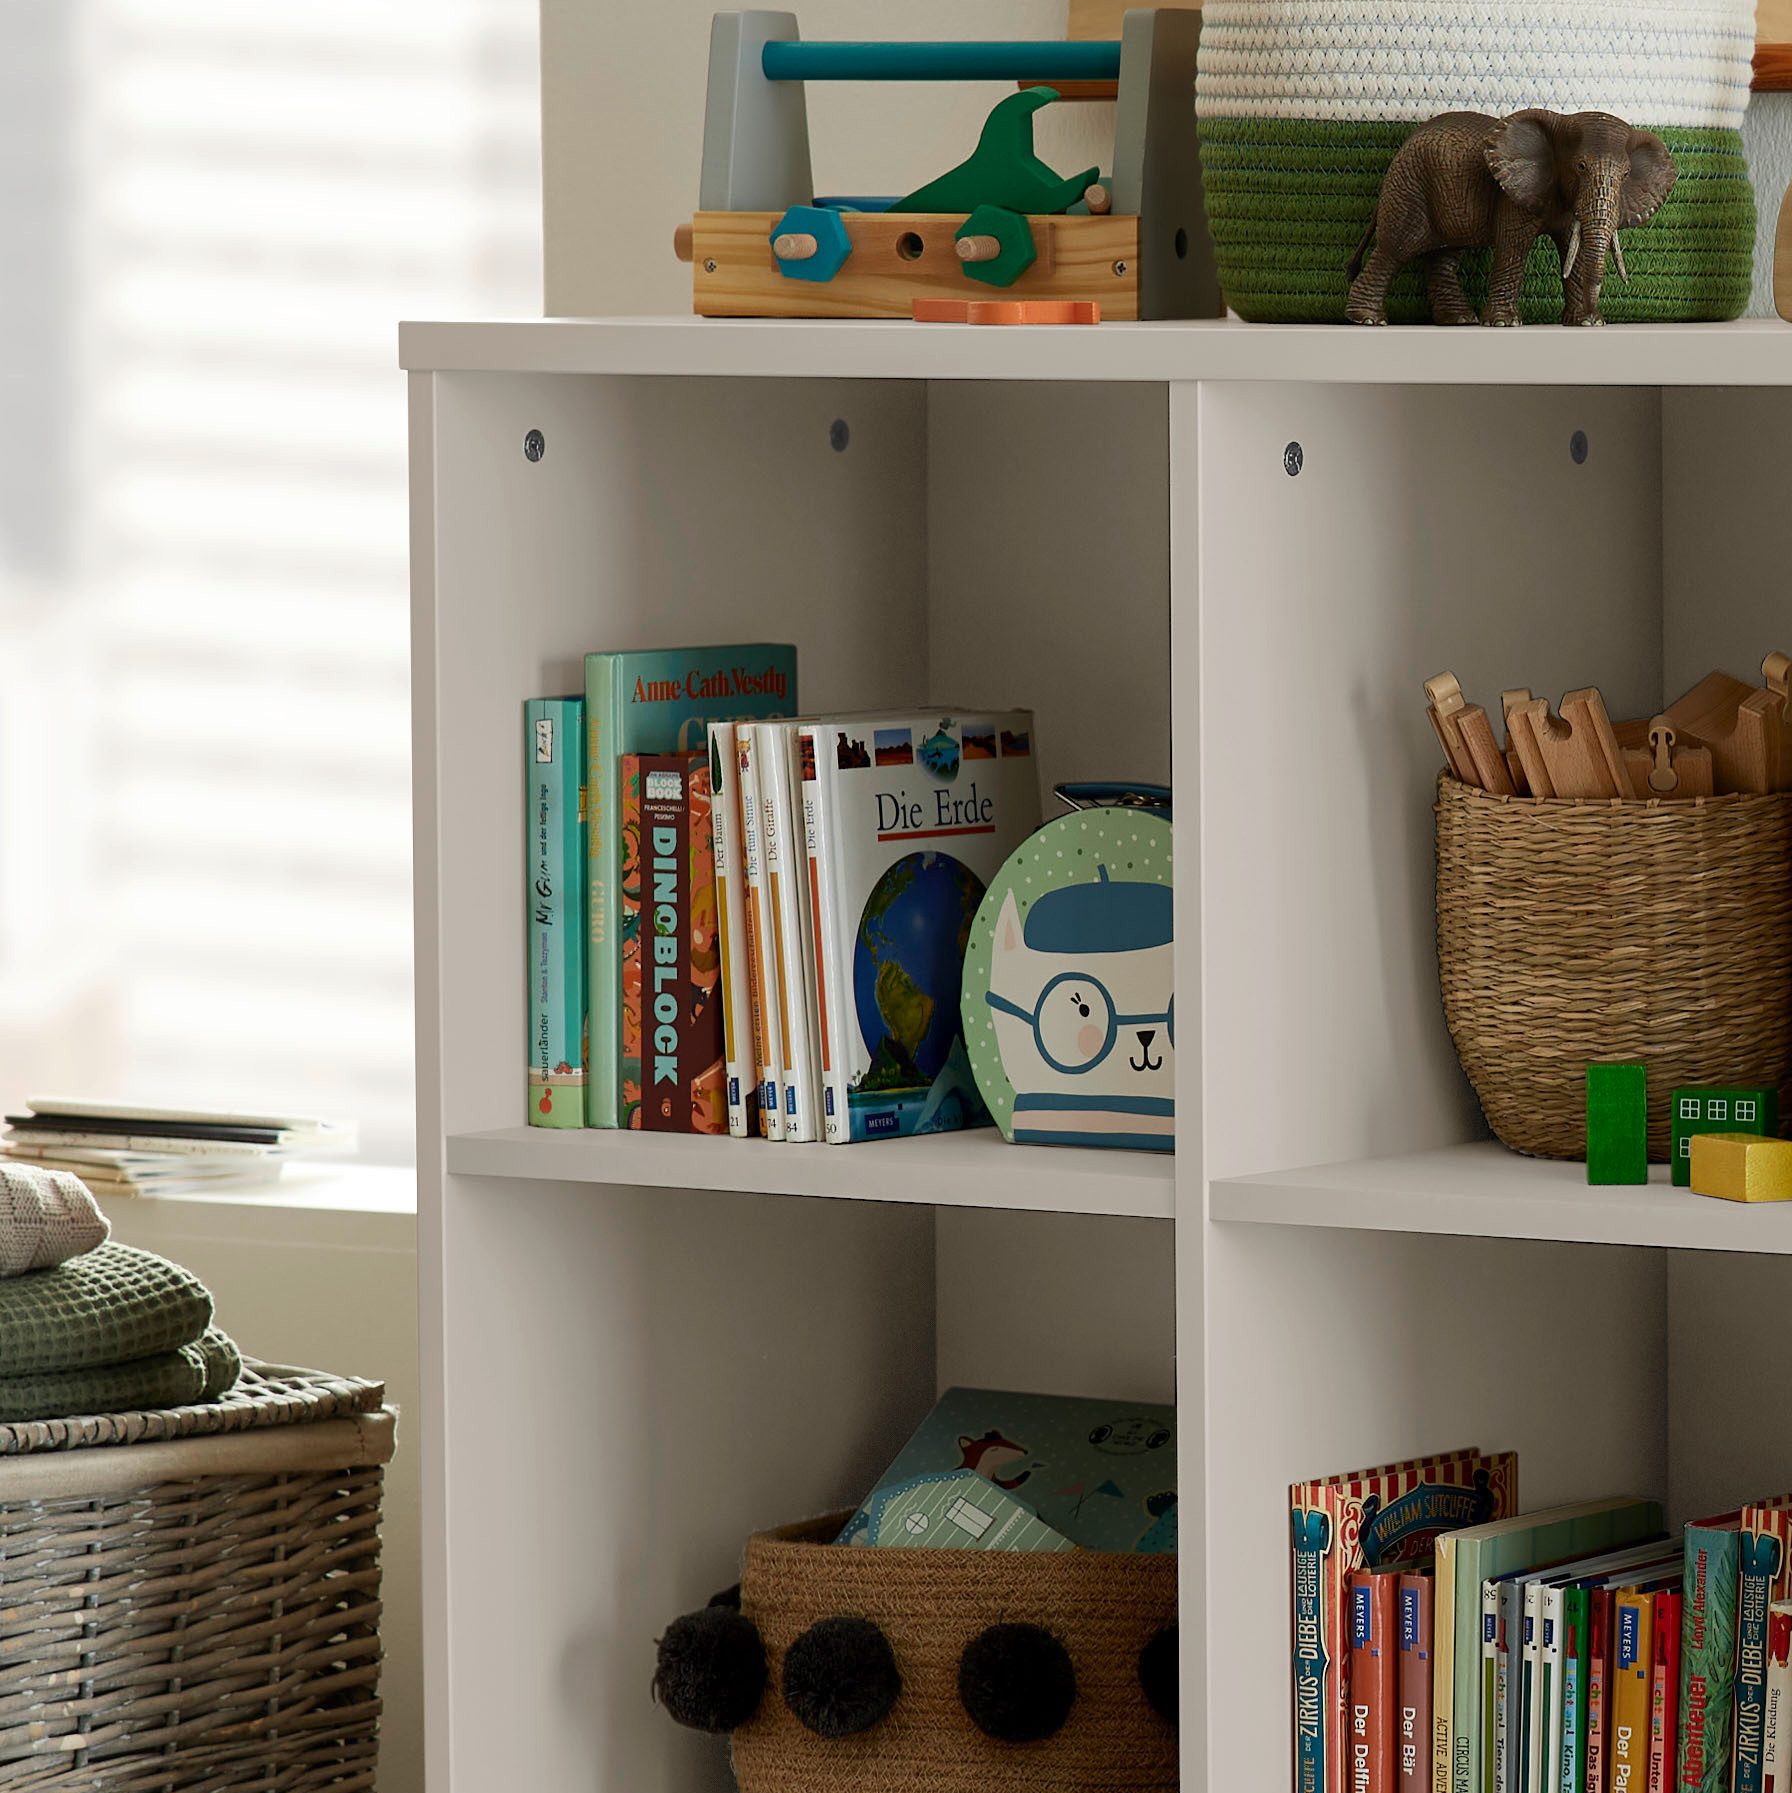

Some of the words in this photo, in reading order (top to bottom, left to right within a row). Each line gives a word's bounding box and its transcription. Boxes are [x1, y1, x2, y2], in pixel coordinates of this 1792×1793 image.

[646, 777, 683, 789] BLOCK
[646, 788, 683, 800] BOOK
[745, 794, 756, 826] Sinne
[765, 798, 776, 837] Giraffe
[805, 799, 814, 825] Erde
[875, 791, 923, 831] Die
[933, 782, 993, 826] Erde
[714, 812, 723, 845] Baum
[807, 828, 816, 849] Die
[715, 849, 725, 869] Der
[749, 856, 758, 876] Die
[769, 840, 778, 861] Die
[535, 901, 553, 926] Mr
[653, 827, 678, 1086] DINOBLOCK
[538, 1012, 549, 1082] sauerländer
[730, 1117, 739, 1127] 21
[786, 1122, 798, 1133] 84
[869, 1117, 894, 1129] MEYERS
[1374, 1498, 1423, 1543] WILLIAM
[1424, 1494, 1478, 1524] SUTCLIFFE
[1297, 1550, 1307, 1597] LAUSIGE
[1307, 1550, 1317, 1597] LOTTERIE
[1692, 1548, 1708, 1613] Alexander
[1484, 1589, 1497, 1600] 58
[1743, 1573, 1755, 1621] LAUSIGE
[1753, 1575, 1766, 1622] LOTTERIE
[1355, 1594, 1365, 1638] MEYERS
[1404, 1595, 1413, 1640] MEYERS
[1690, 1615, 1707, 1650] Lloyd
[1298, 1614, 1319, 1660] DIEBE
[1622, 1613, 1634, 1659] MEYERS
[1741, 1638, 1763, 1685] DIEBE
[1298, 1675, 1319, 1738] ZIRKUS
[1354, 1704, 1369, 1737] Der
[1403, 1707, 1416, 1739] Der
[1766, 1688, 1781, 1740] Kleidung
[1436, 1717, 1449, 1757] ACTIVE
[1617, 1725, 1633, 1759] Der
[1680, 1673, 1707, 1788] Abenteuer
[1739, 1700, 1761, 1765] ZIRKUS
[1403, 1744, 1416, 1776] Bär
[1456, 1736, 1470, 1775] CIRCUS
[1495, 1737, 1505, 1771] Tiere
[1561, 1744, 1574, 1779] Kino,
[1588, 1744, 1600, 1770] Das
[1764, 1742, 1776, 1763] Die
[1650, 1751, 1662, 1791] Unter
[1743, 1762, 1751, 1779] DER
